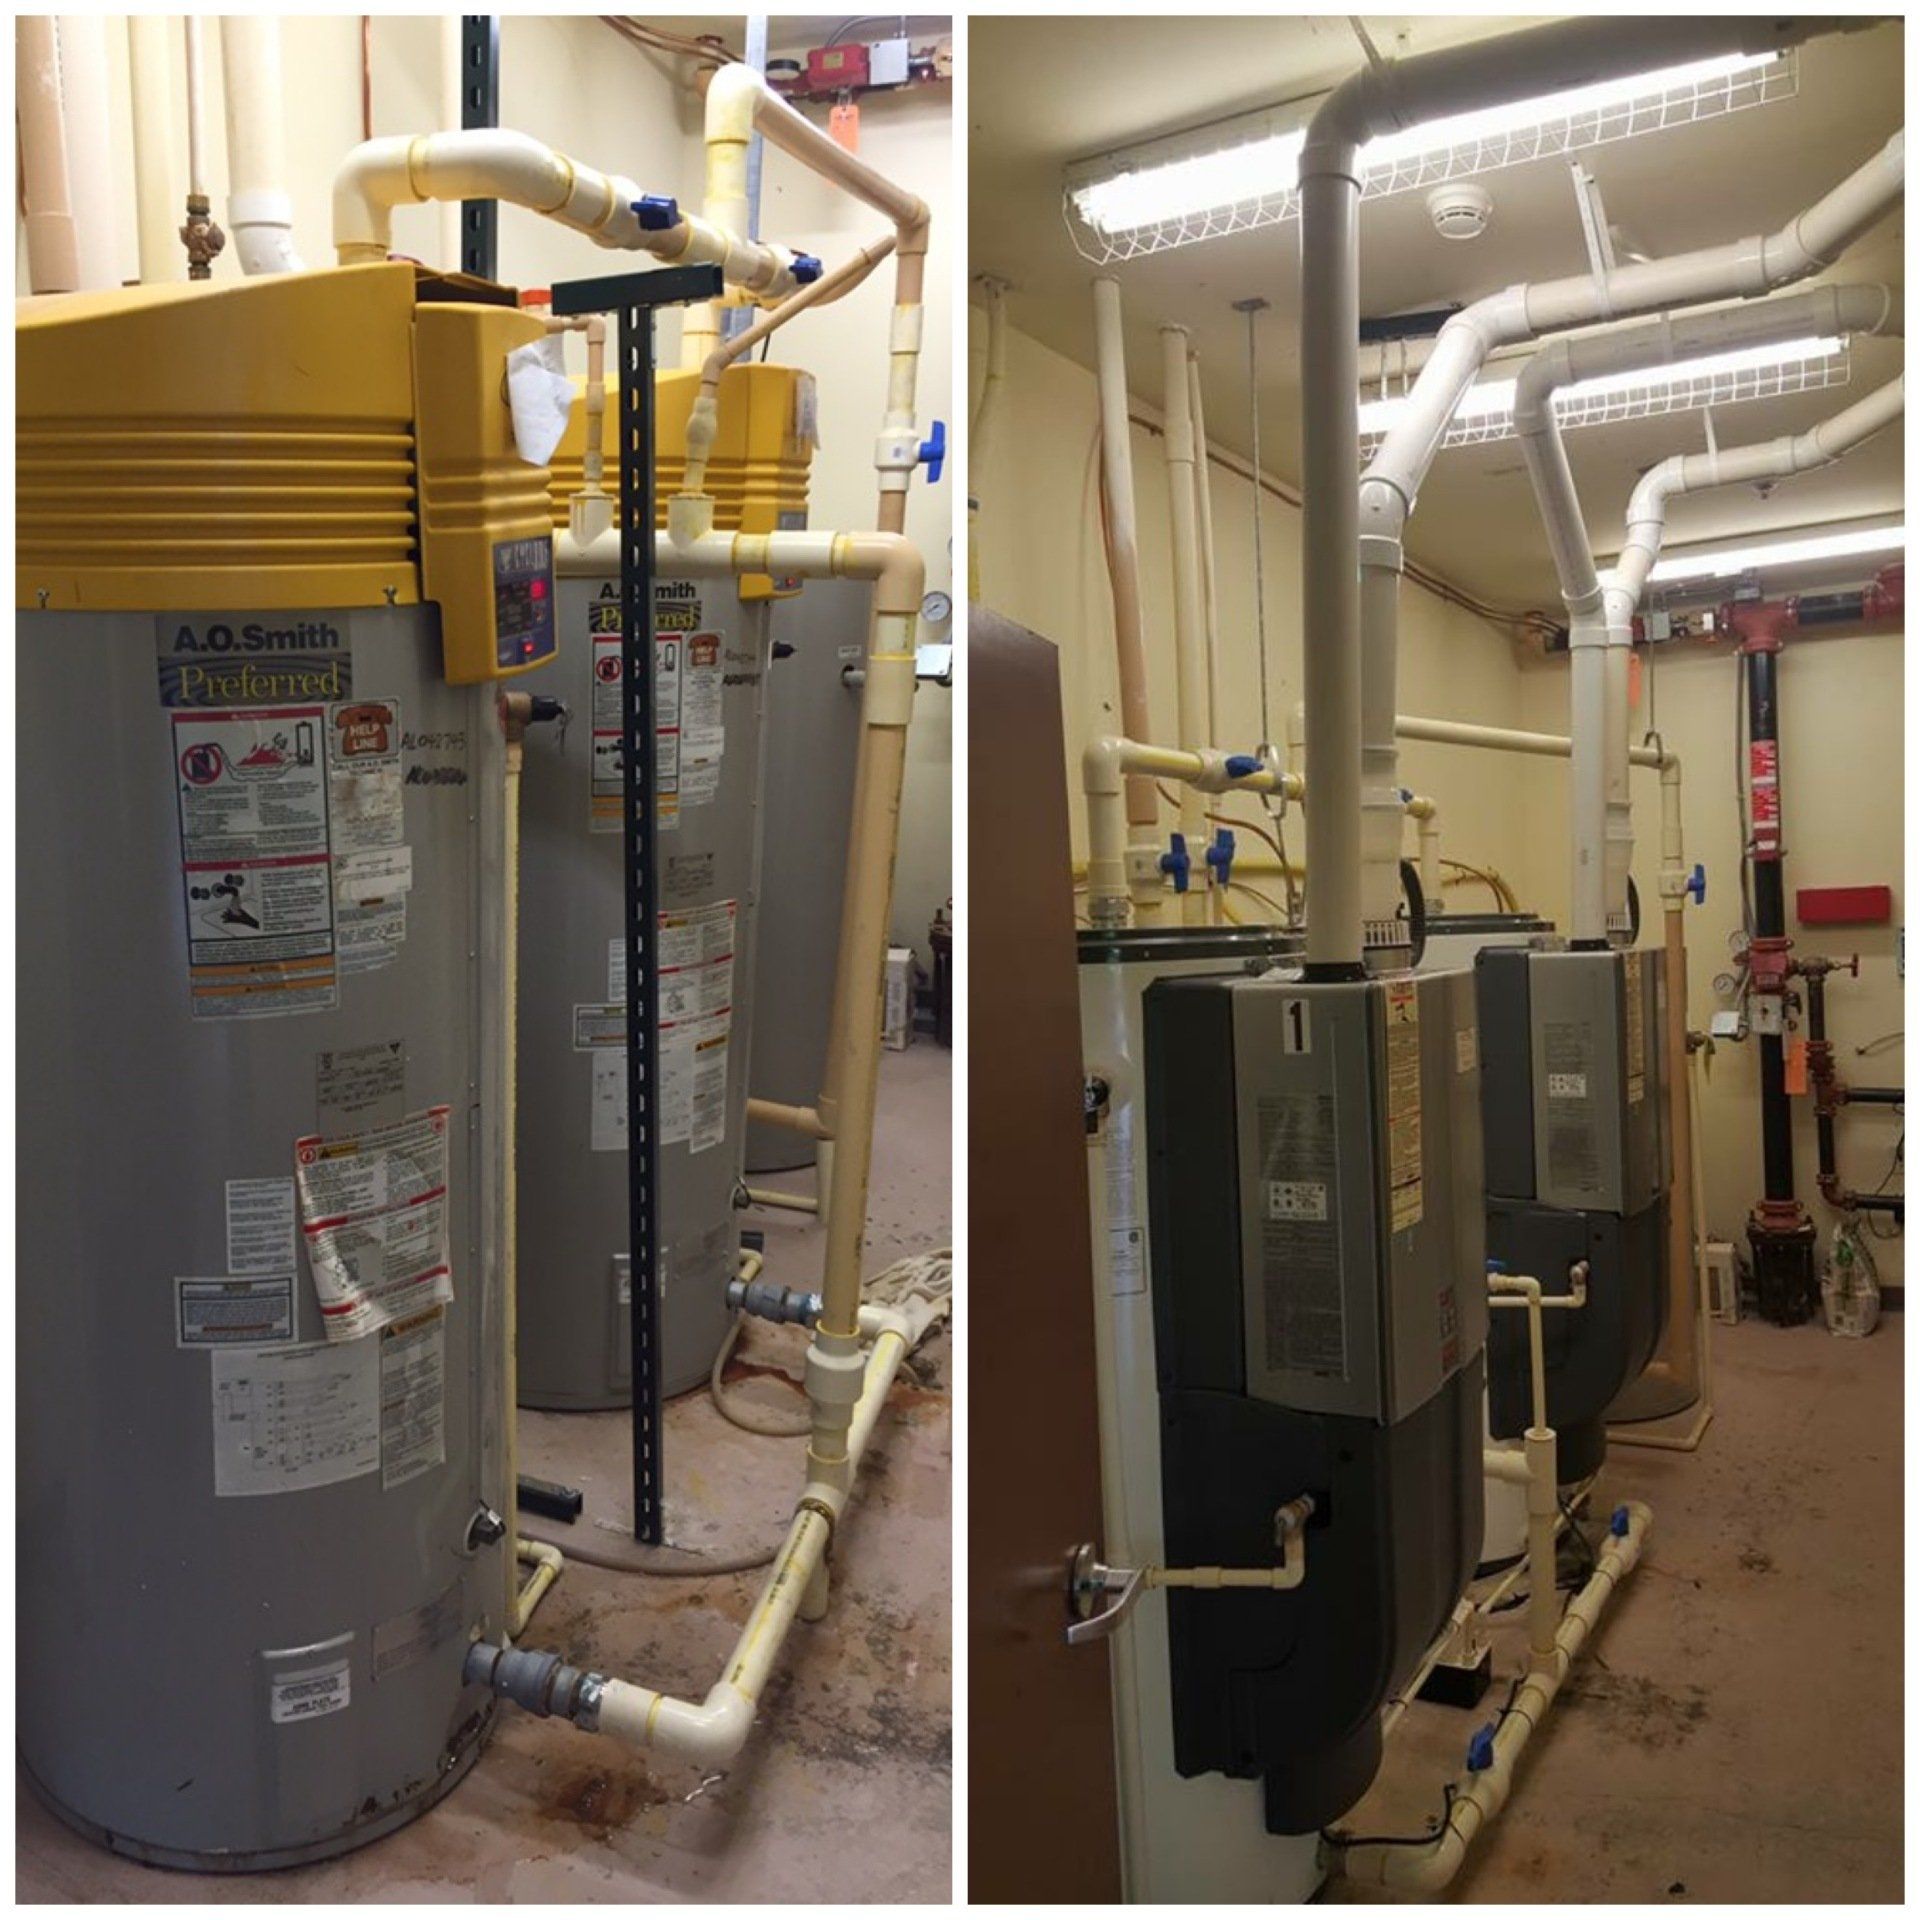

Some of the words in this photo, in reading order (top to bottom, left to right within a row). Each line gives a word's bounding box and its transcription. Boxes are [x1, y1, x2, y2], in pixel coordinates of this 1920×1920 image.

[174, 622, 339, 651] A.O.Smith
[179, 661, 342, 699] Preferred
[349, 722, 381, 737] HELP
[352, 737, 379, 750] LINE
[1289, 1001, 1304, 1052] 1
